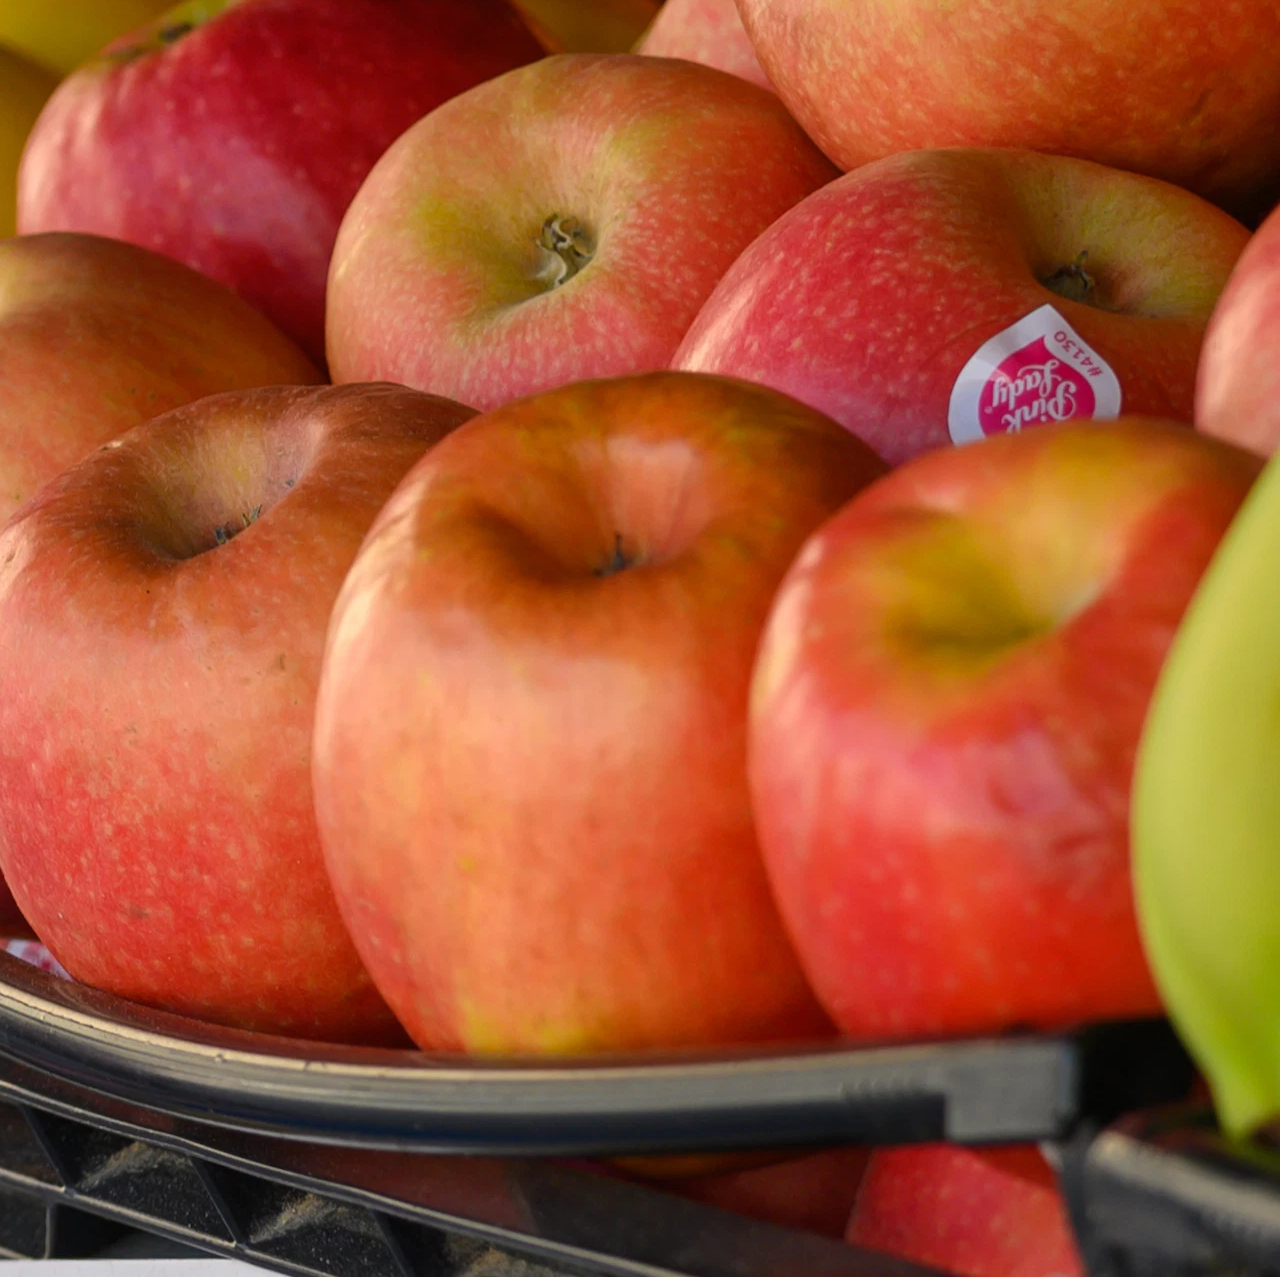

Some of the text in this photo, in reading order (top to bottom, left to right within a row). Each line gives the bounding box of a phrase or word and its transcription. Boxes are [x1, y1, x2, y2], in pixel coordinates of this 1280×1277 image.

[1053, 330, 1103, 377] #4130
[992, 359, 1061, 410] Lady
[1001, 381, 1077, 434] Pink
